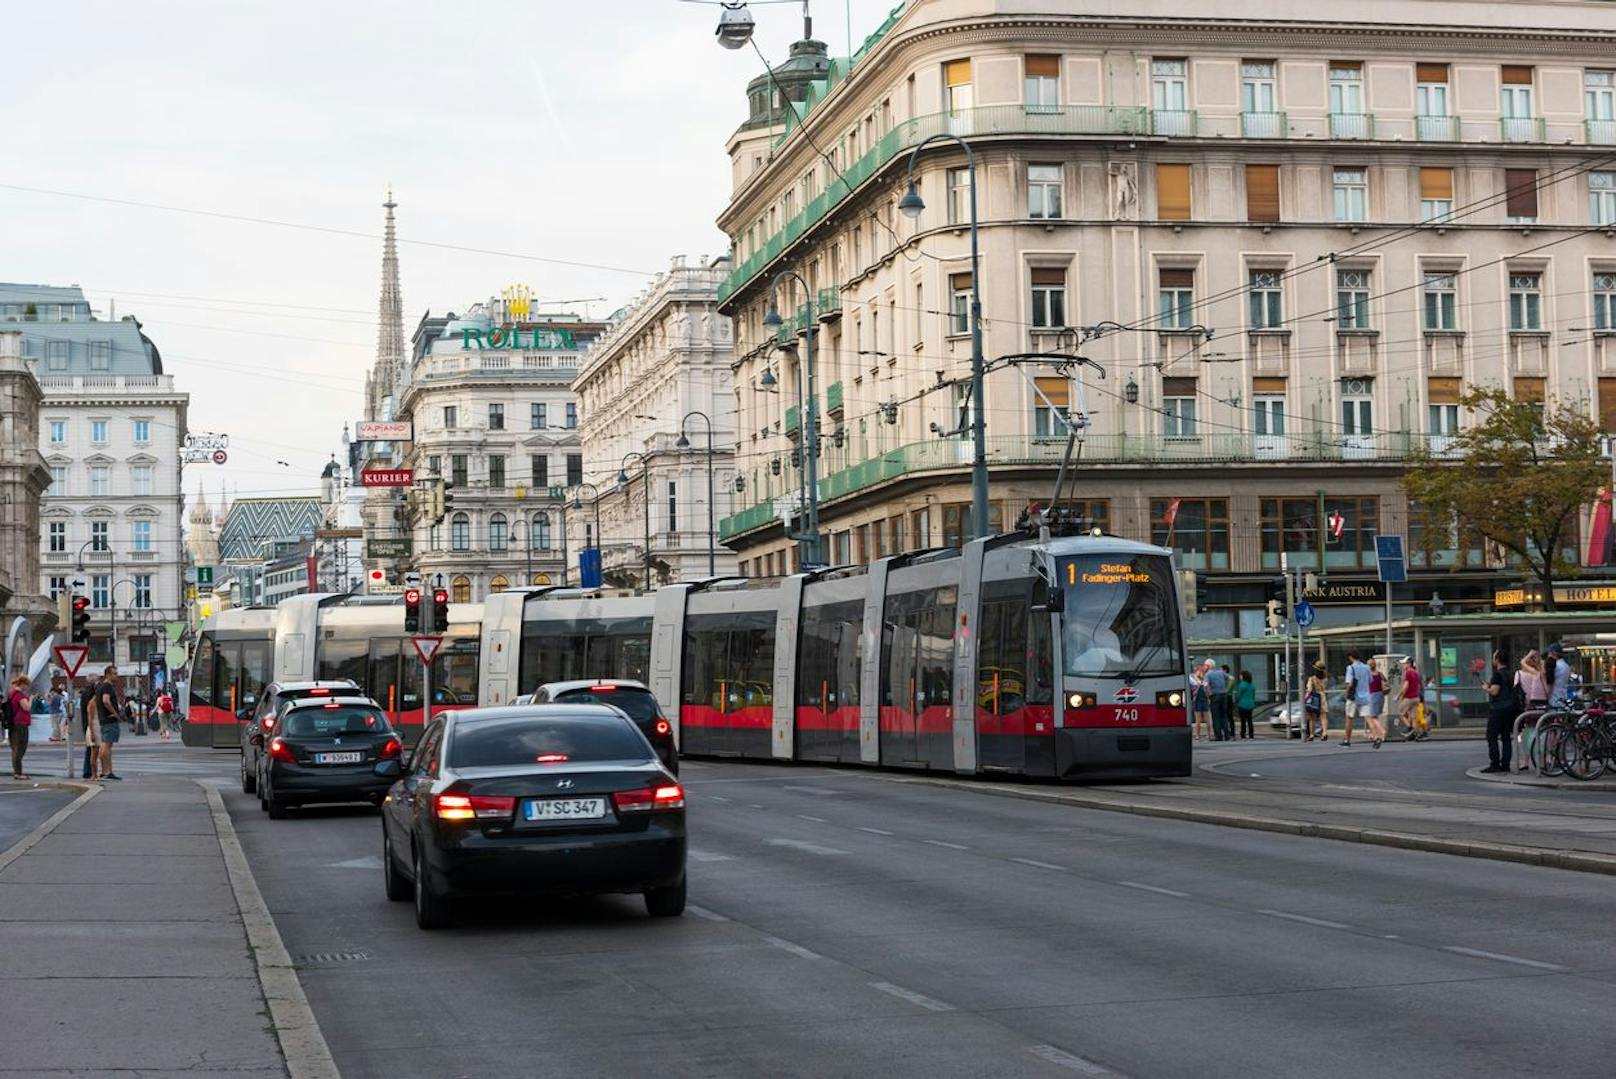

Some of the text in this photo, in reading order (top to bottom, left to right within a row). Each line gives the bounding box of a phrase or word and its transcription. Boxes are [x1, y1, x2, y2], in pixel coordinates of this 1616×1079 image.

[461, 327, 578, 350] ROLEX
[364, 473, 410, 483] KURIER
[1067, 563, 1076, 585] 1
[1101, 564, 1132, 573] Stefan
[1082, 573, 1150, 584] Fadinger-Platz
[1329, 586, 1377, 597] AUSTRIA
[1567, 587, 1615, 600] HOTEL
[1114, 708, 1138, 721] 740
